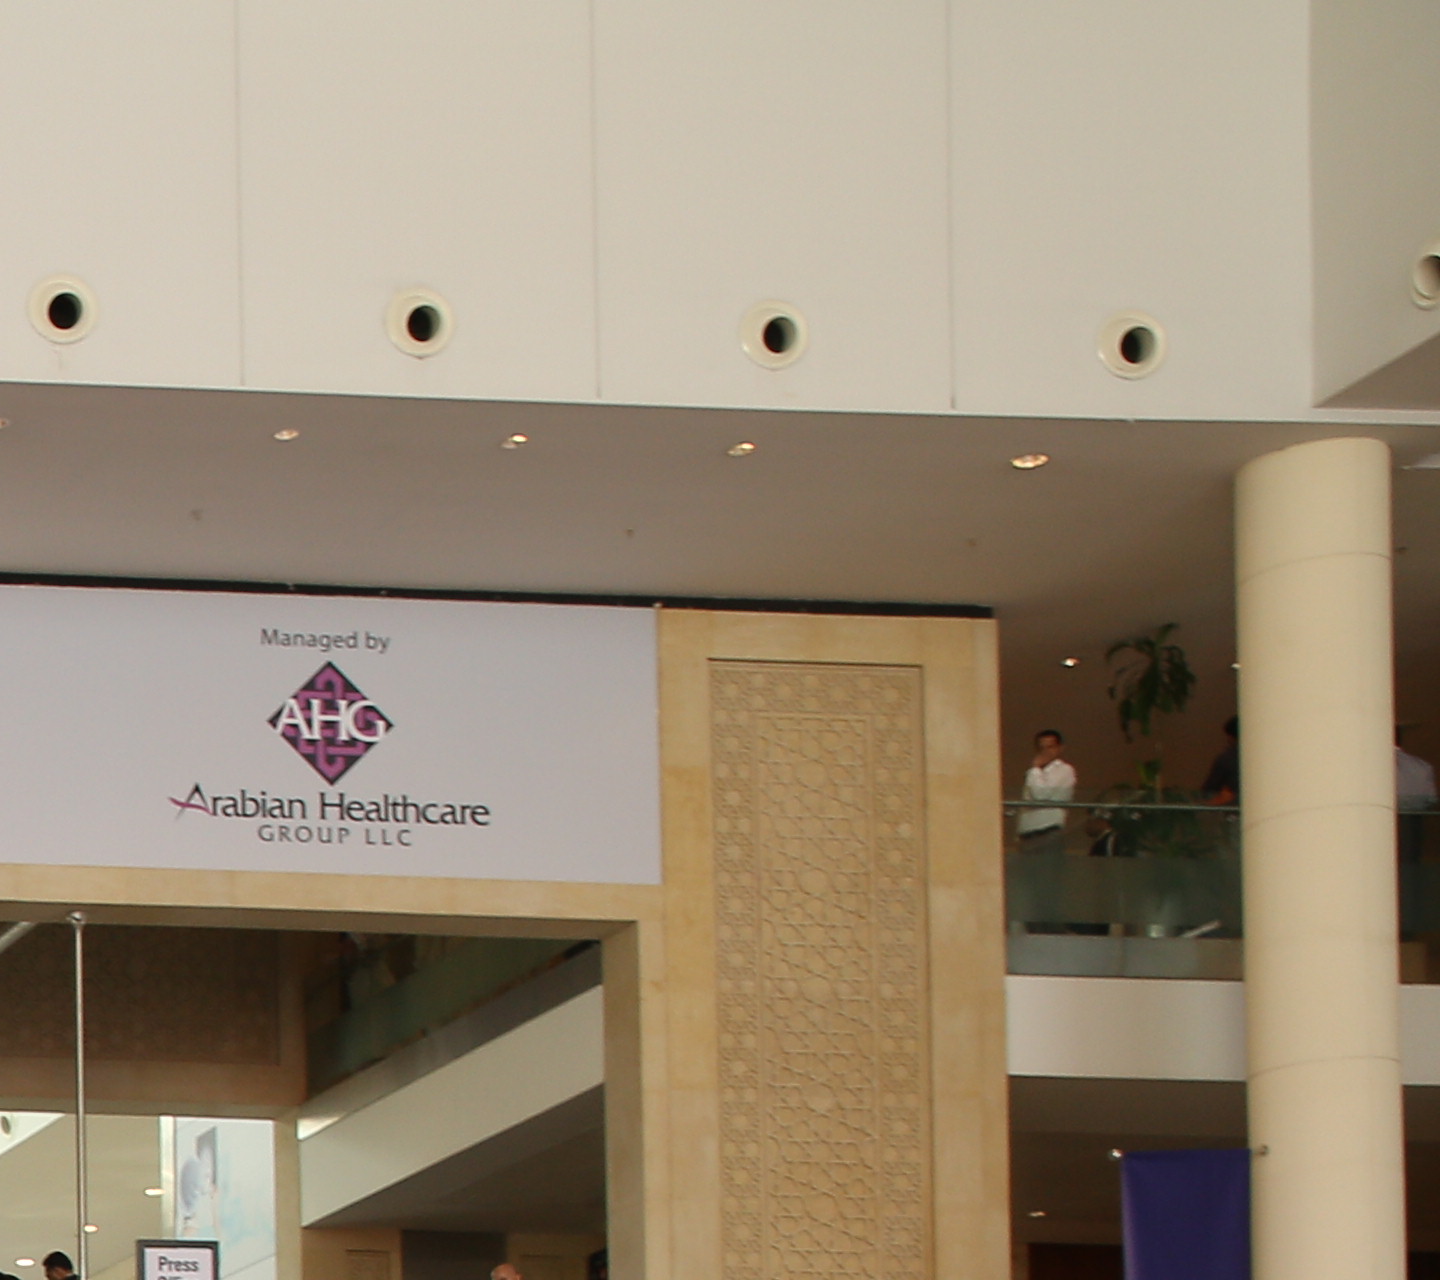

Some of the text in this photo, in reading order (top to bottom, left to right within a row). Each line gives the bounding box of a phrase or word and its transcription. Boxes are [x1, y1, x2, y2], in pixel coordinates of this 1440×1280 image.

[260, 628, 391, 654] Managed by
[275, 698, 386, 743] AHG
[167, 782, 491, 827] Arabian Healthcare
[257, 824, 413, 847] GROUP LLC
[158, 1256, 198, 1271] Press
